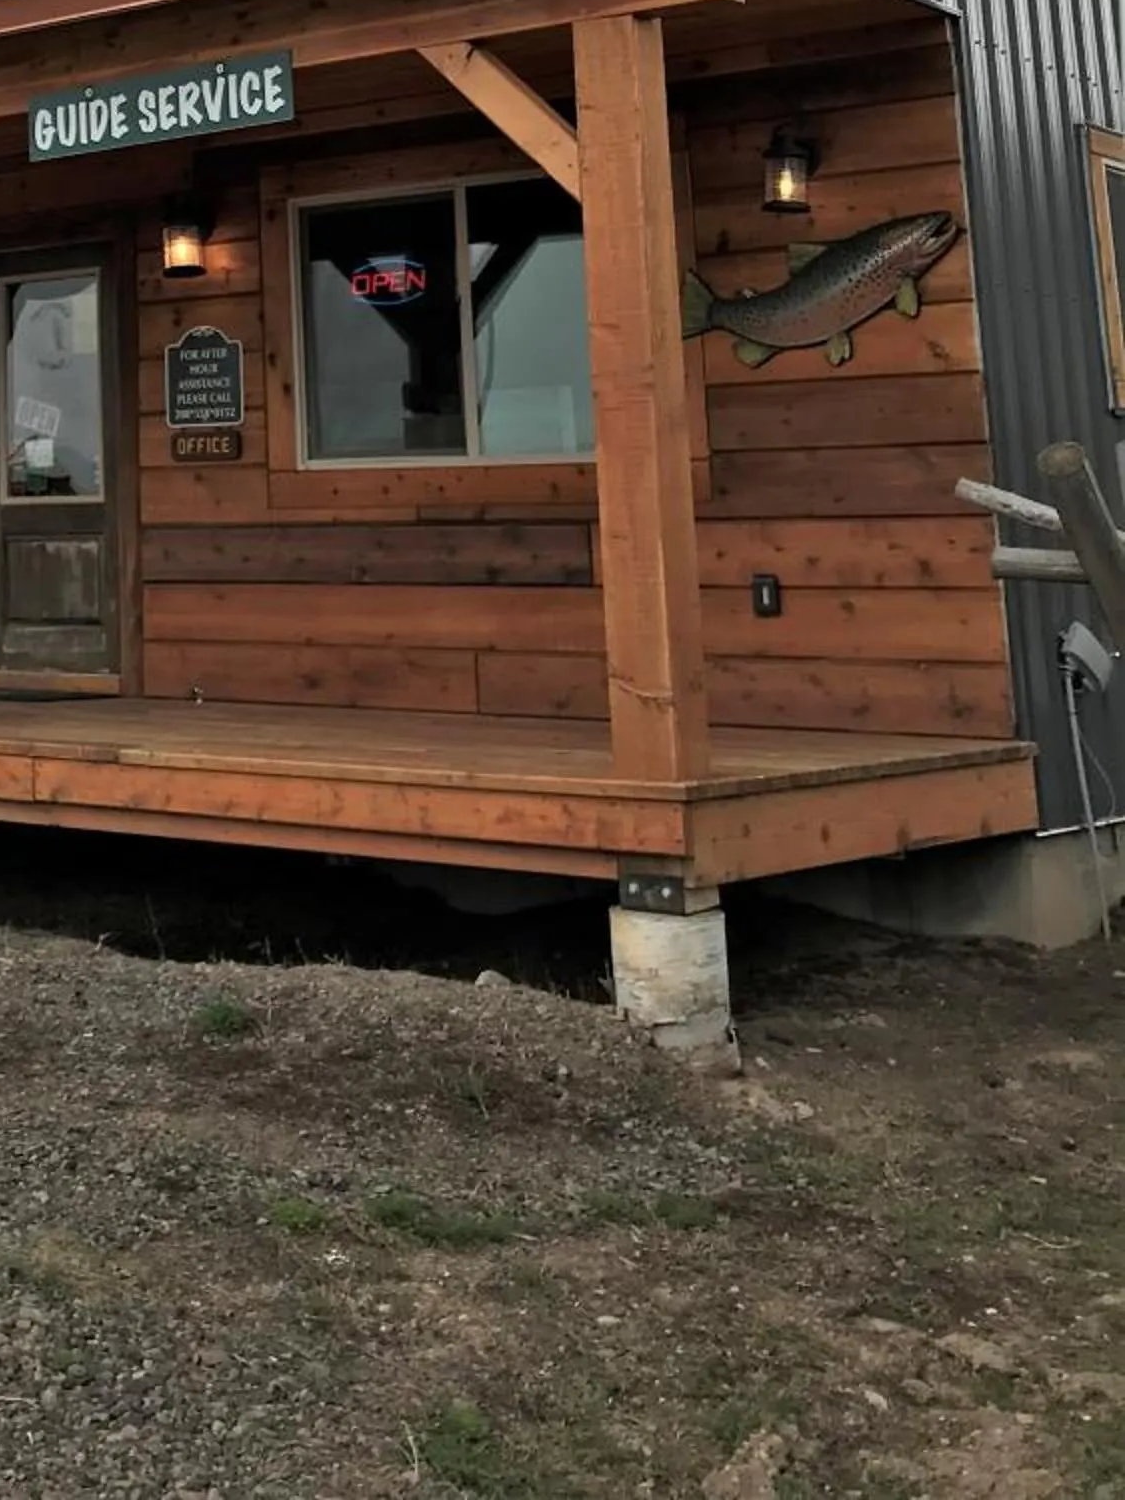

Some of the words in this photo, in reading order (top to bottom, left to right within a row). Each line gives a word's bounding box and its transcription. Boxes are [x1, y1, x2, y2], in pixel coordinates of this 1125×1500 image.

[34, 94, 129, 150] GUIDE
[138, 65, 286, 133] SERVICE
[352, 268, 426, 296] OPEN
[177, 392, 208, 405] PLEASE
[209, 391, 232, 404] CALL
[177, 437, 230, 454] OFFICE
